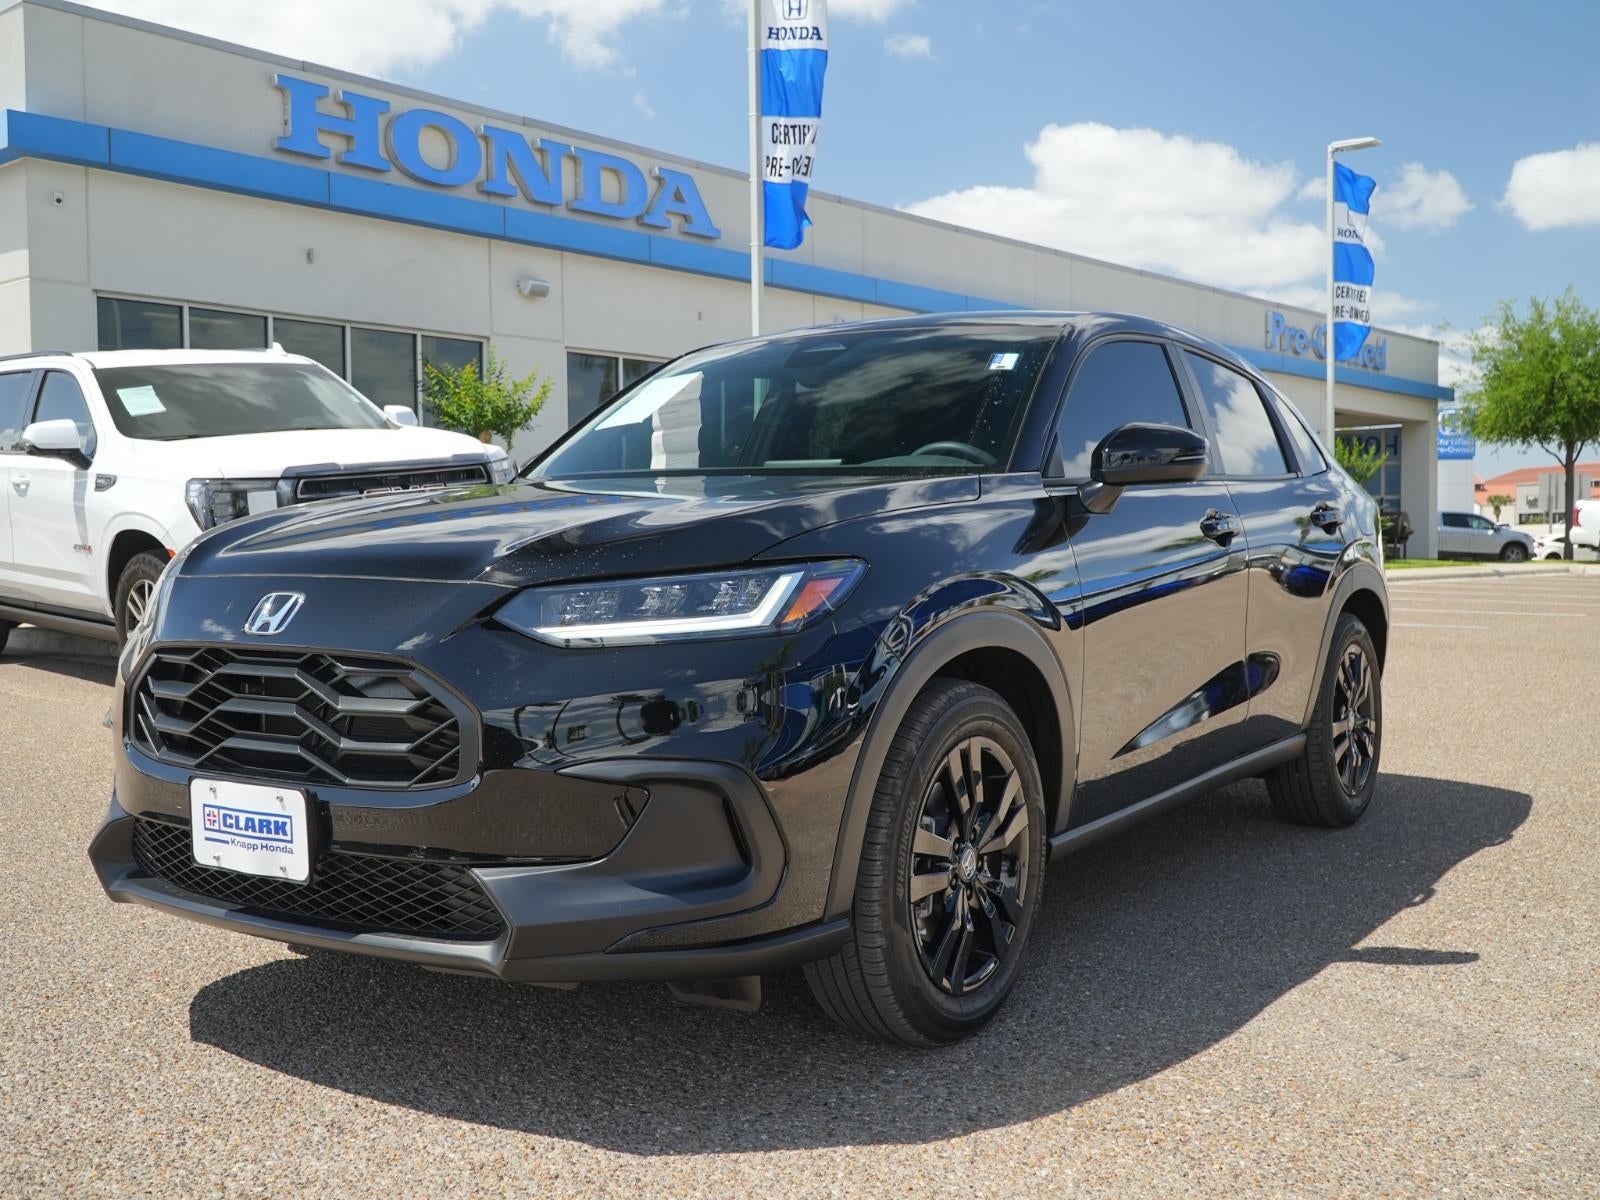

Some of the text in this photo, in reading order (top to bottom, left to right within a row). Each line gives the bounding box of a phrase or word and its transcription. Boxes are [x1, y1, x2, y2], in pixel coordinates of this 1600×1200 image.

[768, 26, 823, 41] HONDA
[273, 74, 721, 240] HONDA
[1337, 227, 1363, 242] HON
[222, 812, 288, 837] CLARK
[230, 837, 294, 855] Knapp Honda
